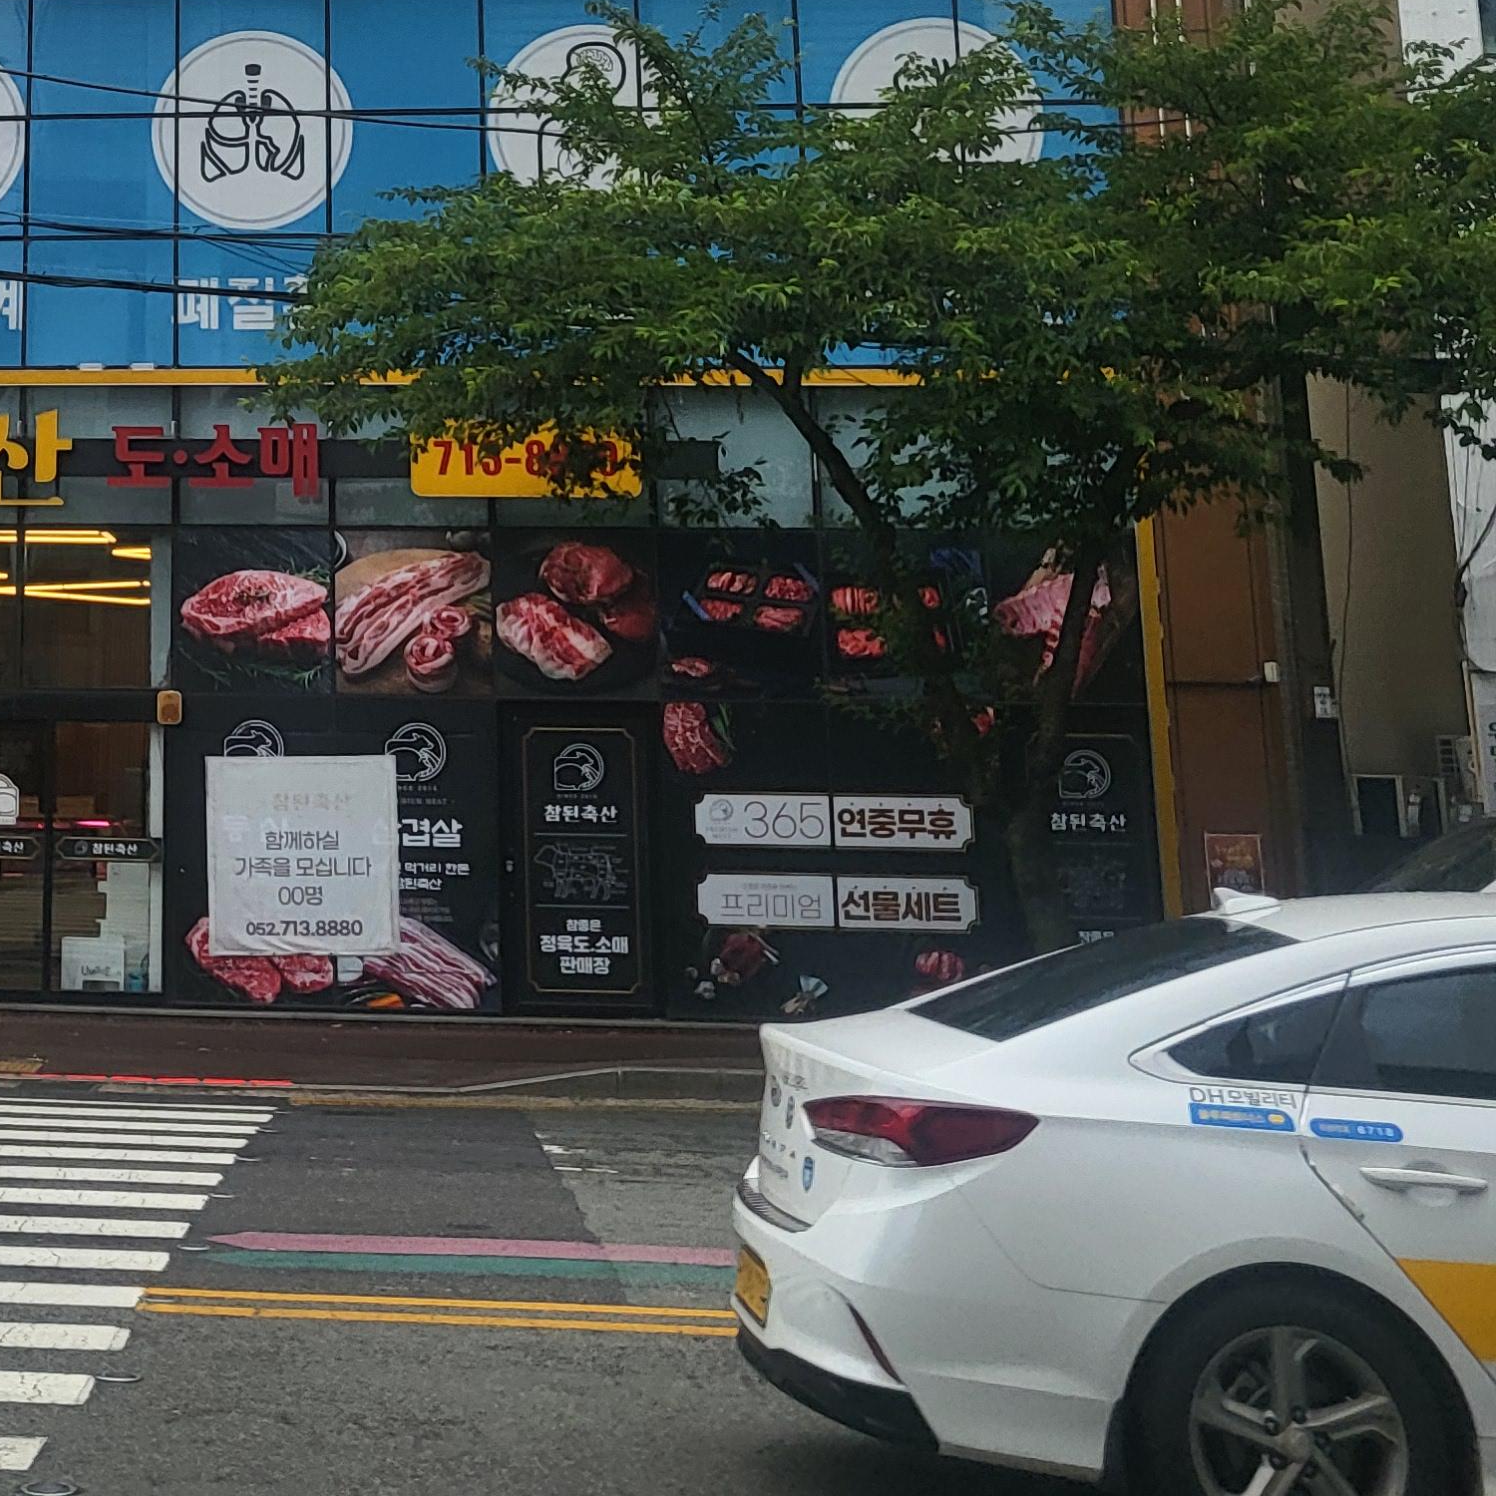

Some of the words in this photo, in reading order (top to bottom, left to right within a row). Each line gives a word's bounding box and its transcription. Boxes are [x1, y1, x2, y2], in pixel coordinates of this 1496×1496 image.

[108, 424, 320, 498] 도·소매
[433, 440, 619, 477] 71-80
[544, 804, 618, 823] 참된축산
[744, 800, 824, 839] 365
[837, 807, 957, 840] 연중무휴
[1050, 812, 1127, 832] 참된축산
[265, 830, 340, 851] 함께하실
[398, 818, 464, 847] 겹살
[92, 841, 138, 855] 참된축산
[235, 857, 291, 878] 가족을
[295, 857, 372, 878] 모십니다
[404, 862, 442, 875] 먹거리
[720, 893, 822, 920] 프리미엄
[841, 890, 962, 922] 선물세트
[245, 919, 363, 937] 052.713.8880
[559, 956, 611, 975] 판매장
